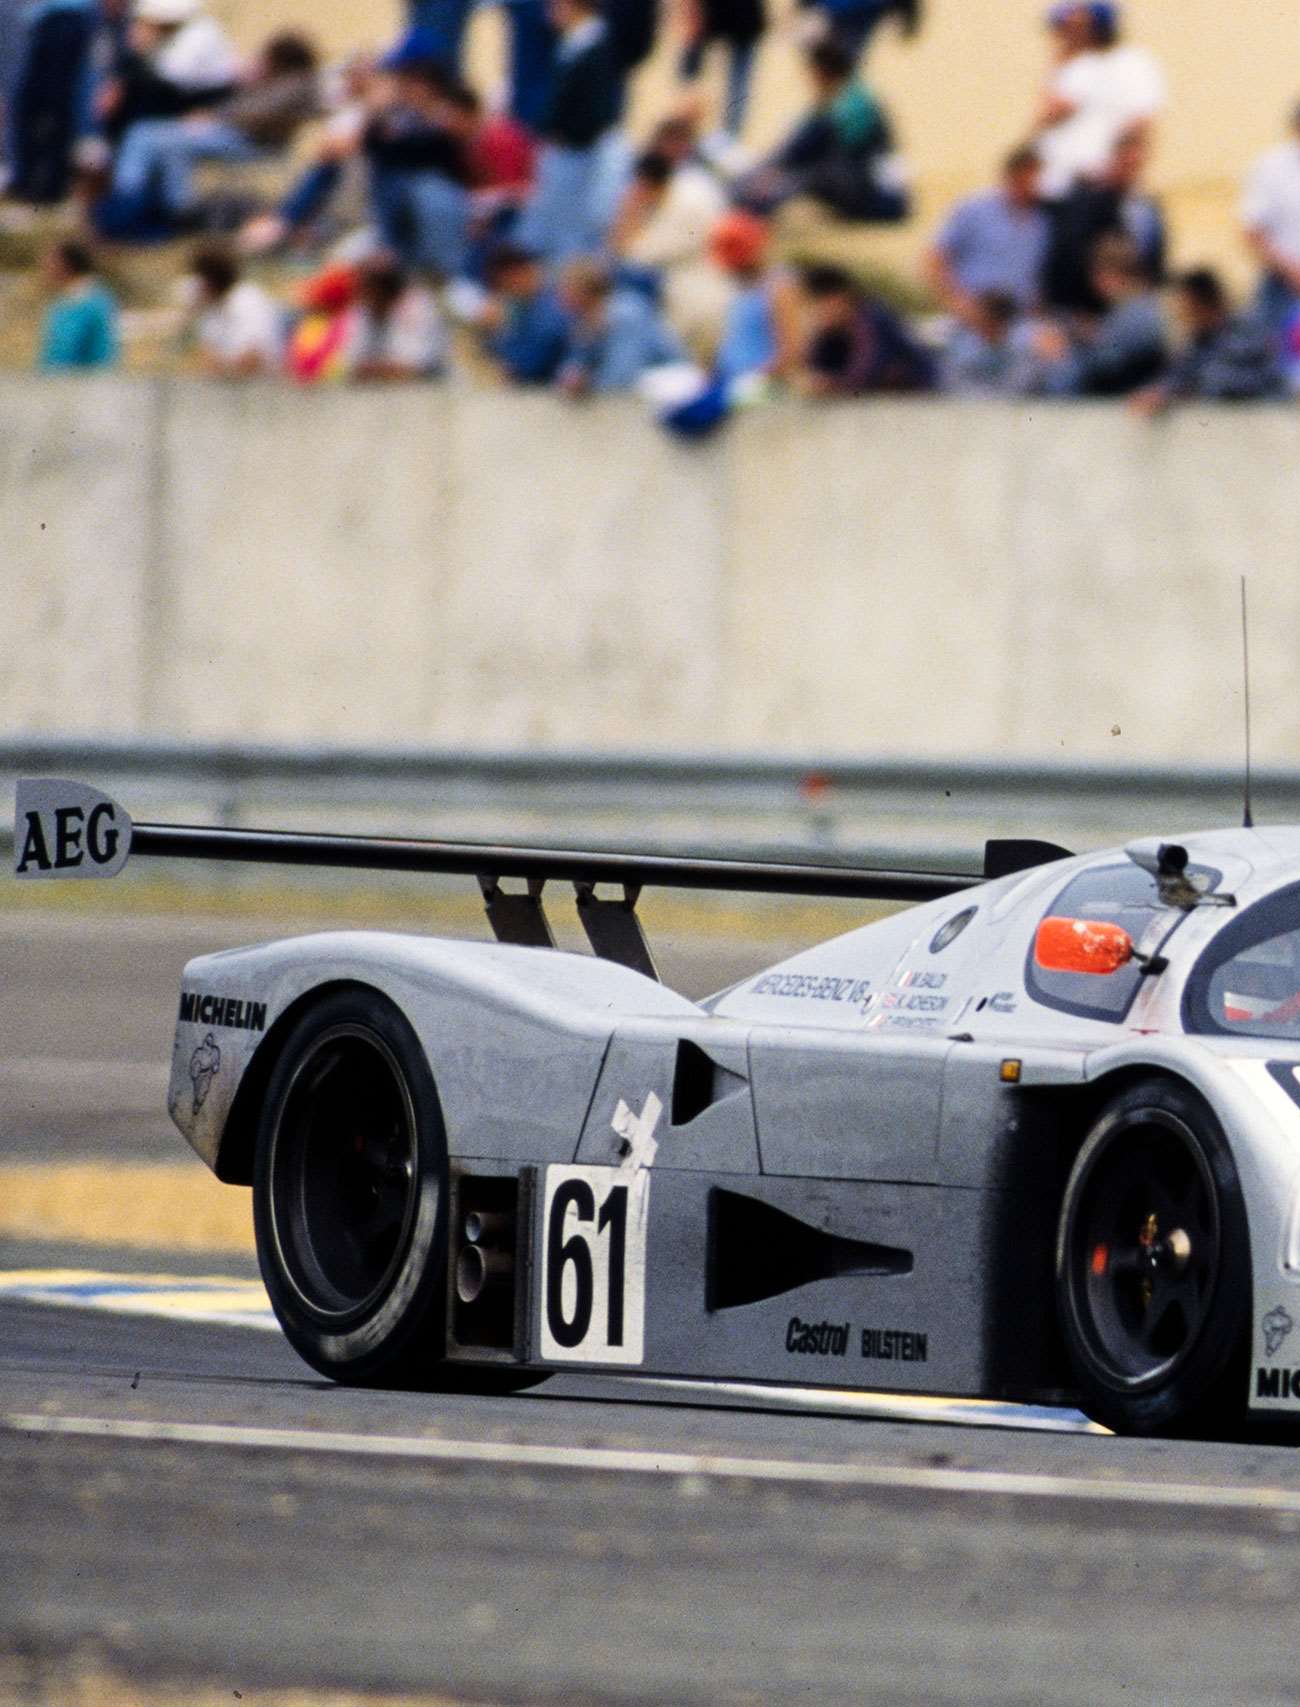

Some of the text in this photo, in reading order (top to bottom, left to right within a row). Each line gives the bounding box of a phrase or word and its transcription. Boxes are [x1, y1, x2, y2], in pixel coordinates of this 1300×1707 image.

[17, 802, 119, 873] AEG
[180, 993, 267, 1032] MICHELIN
[547, 1178, 628, 1348] 61
[786, 1316, 927, 1362] Castrol BILSTEIN
